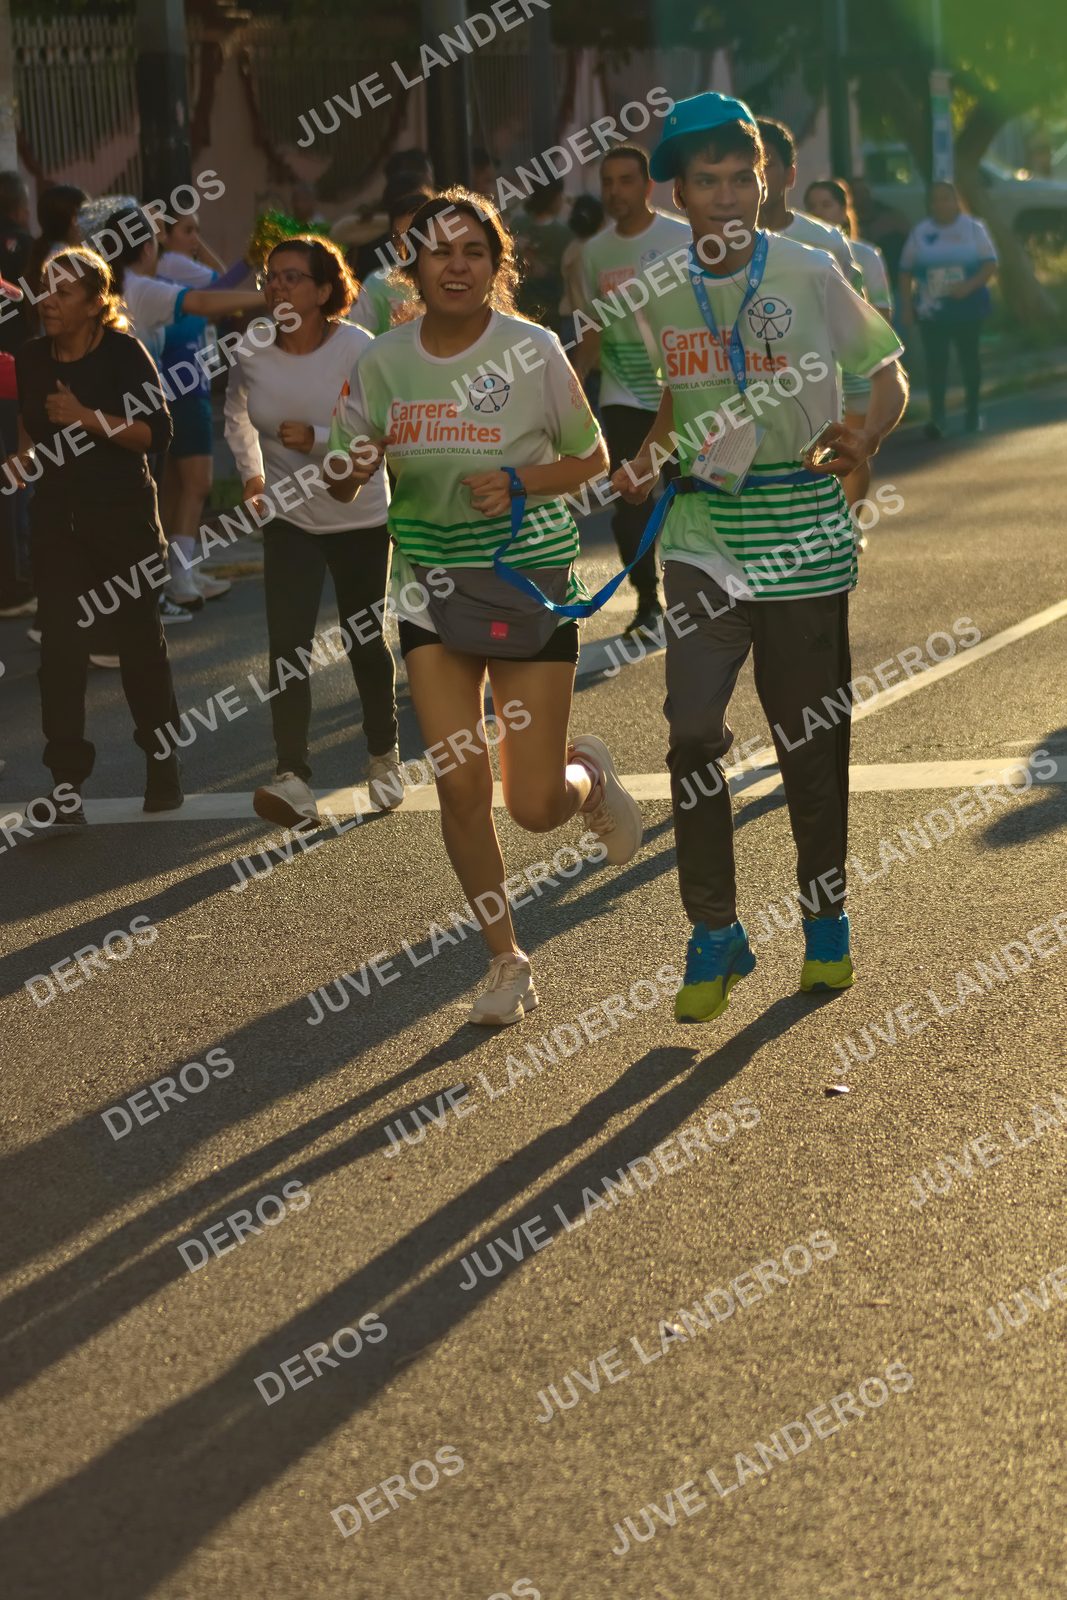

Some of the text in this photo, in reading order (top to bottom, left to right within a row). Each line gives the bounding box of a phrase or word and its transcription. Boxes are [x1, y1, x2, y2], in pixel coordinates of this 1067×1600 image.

[666, 349, 709, 378] SIN
[391, 402, 457, 421] Carrera
[389, 420, 501, 445] SIN límites
[410, 447, 445, 456] VOLUNTAD
[447, 447, 470, 455] CRUZA
